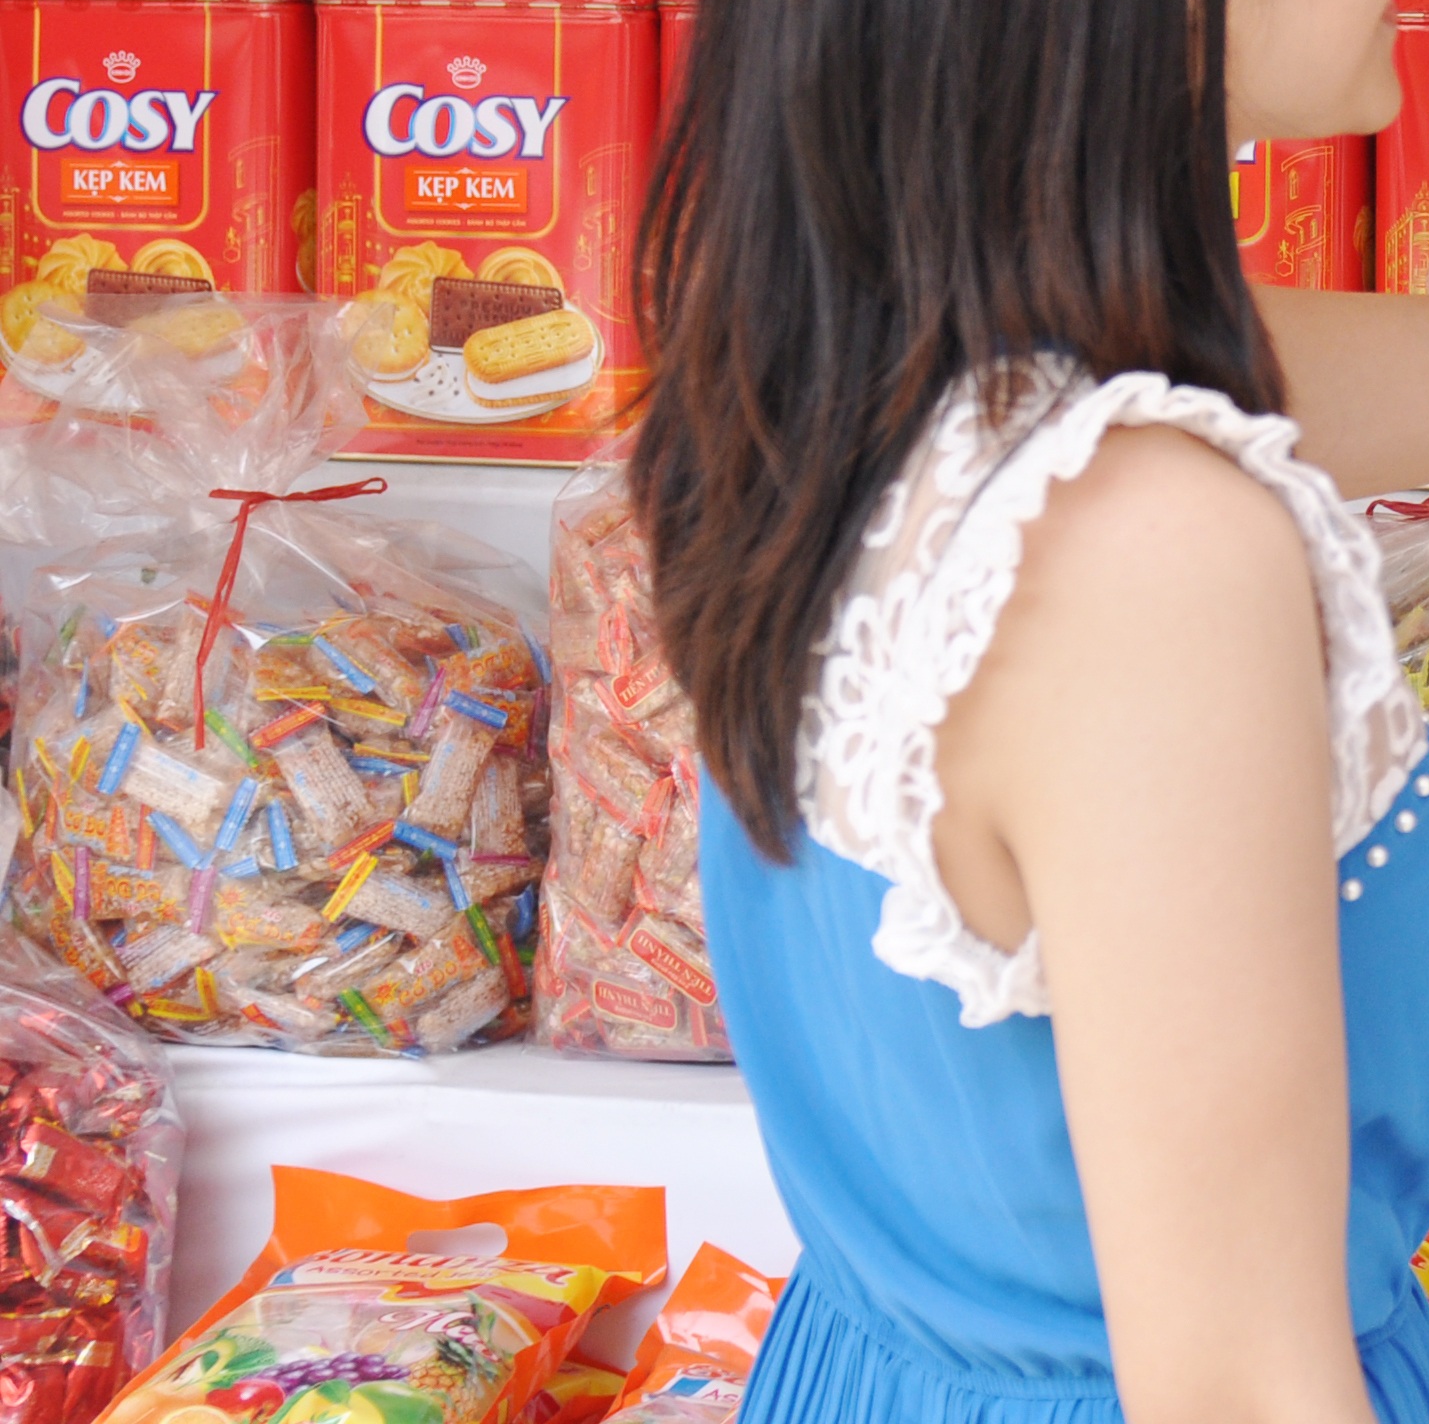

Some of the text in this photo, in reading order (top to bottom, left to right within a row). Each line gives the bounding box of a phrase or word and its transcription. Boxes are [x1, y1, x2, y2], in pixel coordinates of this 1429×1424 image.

[21, 78, 220, 153] COSY
[363, 82, 572, 160] COSY
[73, 168, 167, 197] KẸP KEM
[417, 176, 515, 204] KẸP KEM
